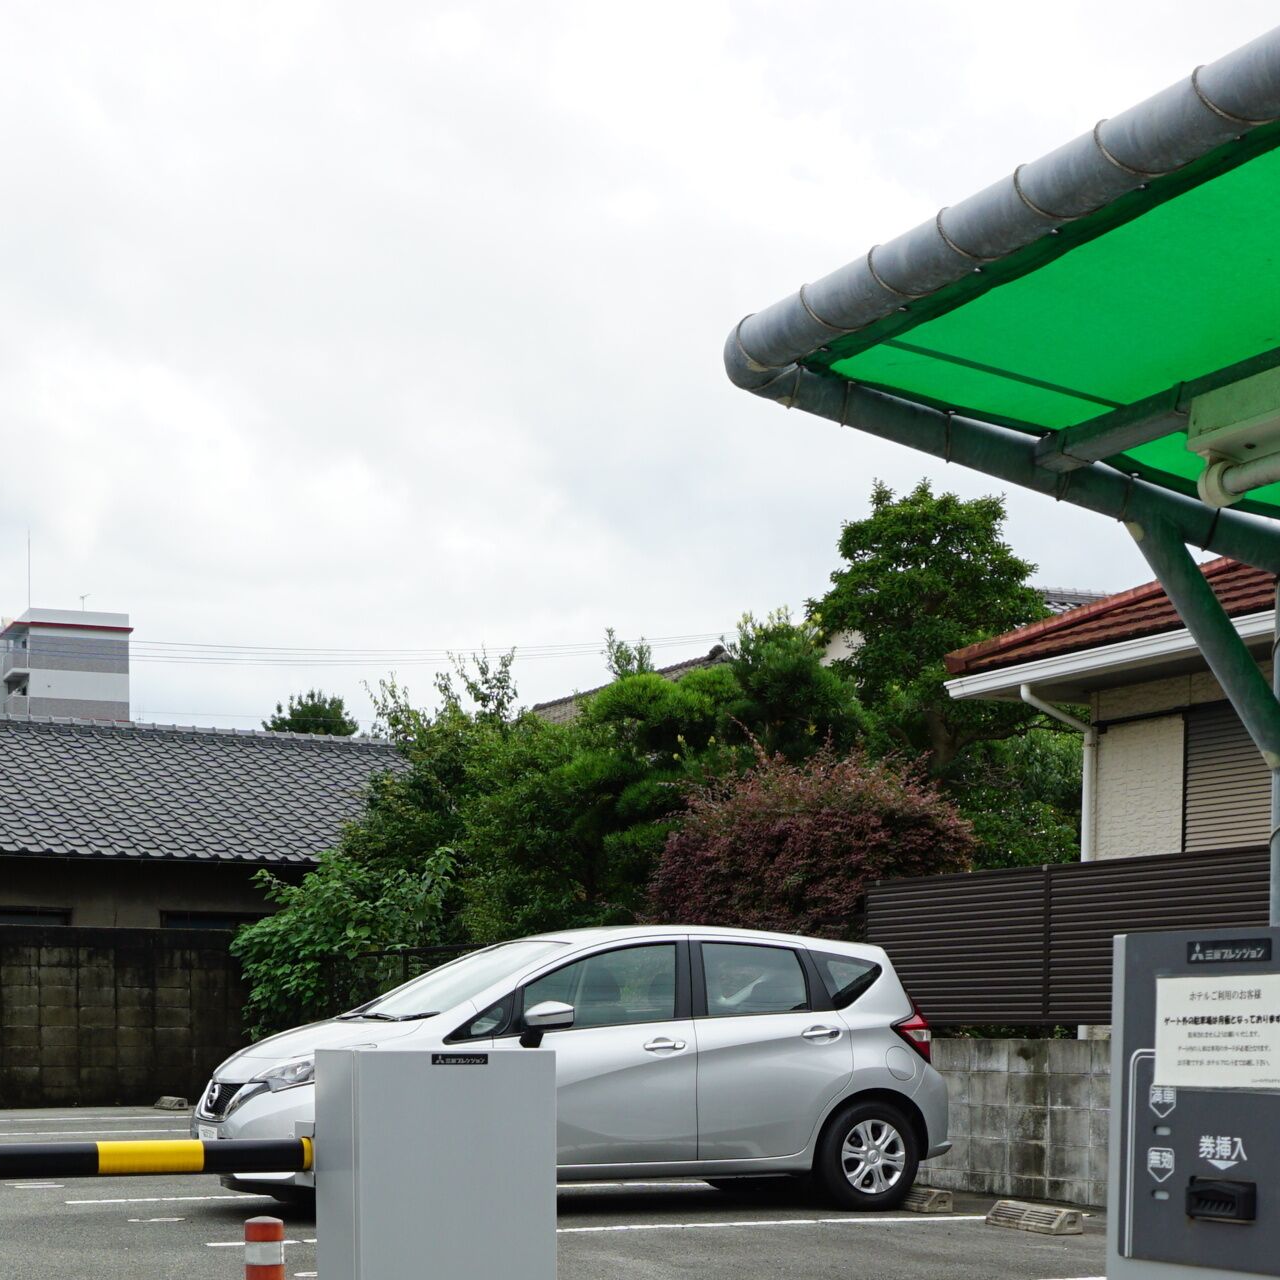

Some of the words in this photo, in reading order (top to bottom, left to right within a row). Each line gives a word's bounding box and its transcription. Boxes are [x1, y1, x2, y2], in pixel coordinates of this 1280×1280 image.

[1189, 989, 1261, 1001] ホテルご利用のお客様
[1199, 1135, 1248, 1160] 券挿入
[1149, 1151, 1173, 1169] 無効
